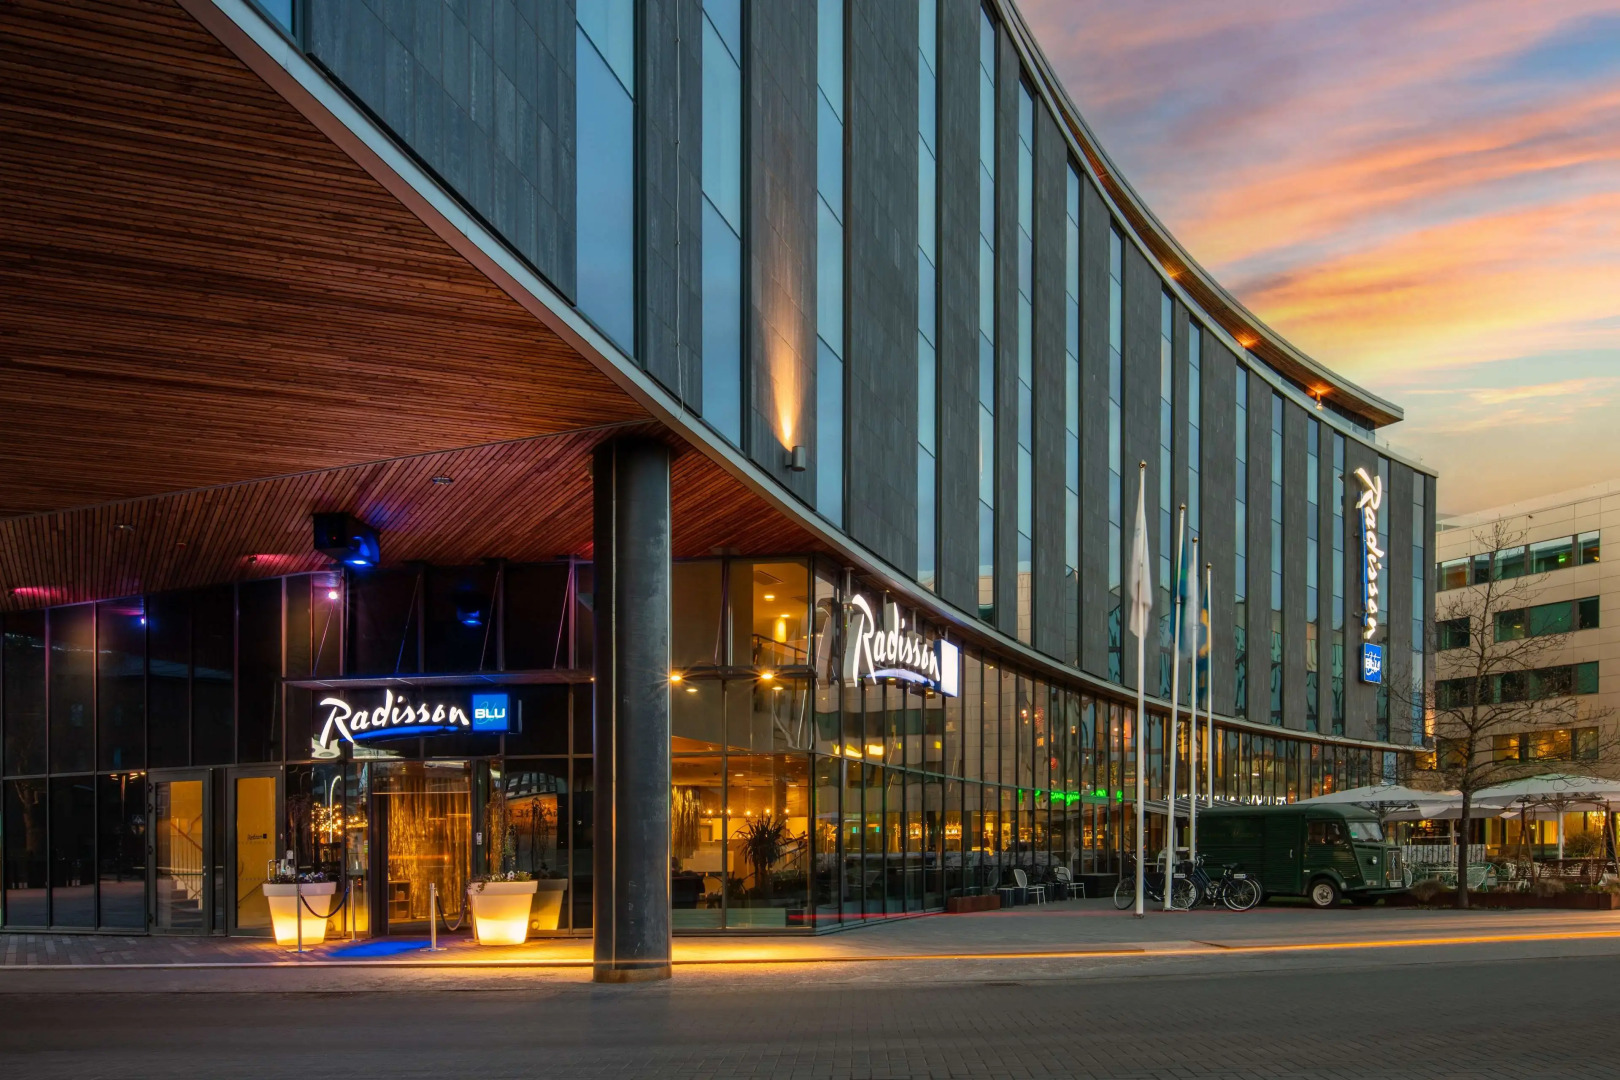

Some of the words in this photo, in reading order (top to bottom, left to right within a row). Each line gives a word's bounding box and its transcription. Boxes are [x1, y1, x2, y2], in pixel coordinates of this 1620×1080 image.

[1354, 467, 1384, 639] Radisson
[852, 594, 940, 687] Radisson
[320, 689, 469, 749] Radisson
[475, 708, 505, 718] BLU
